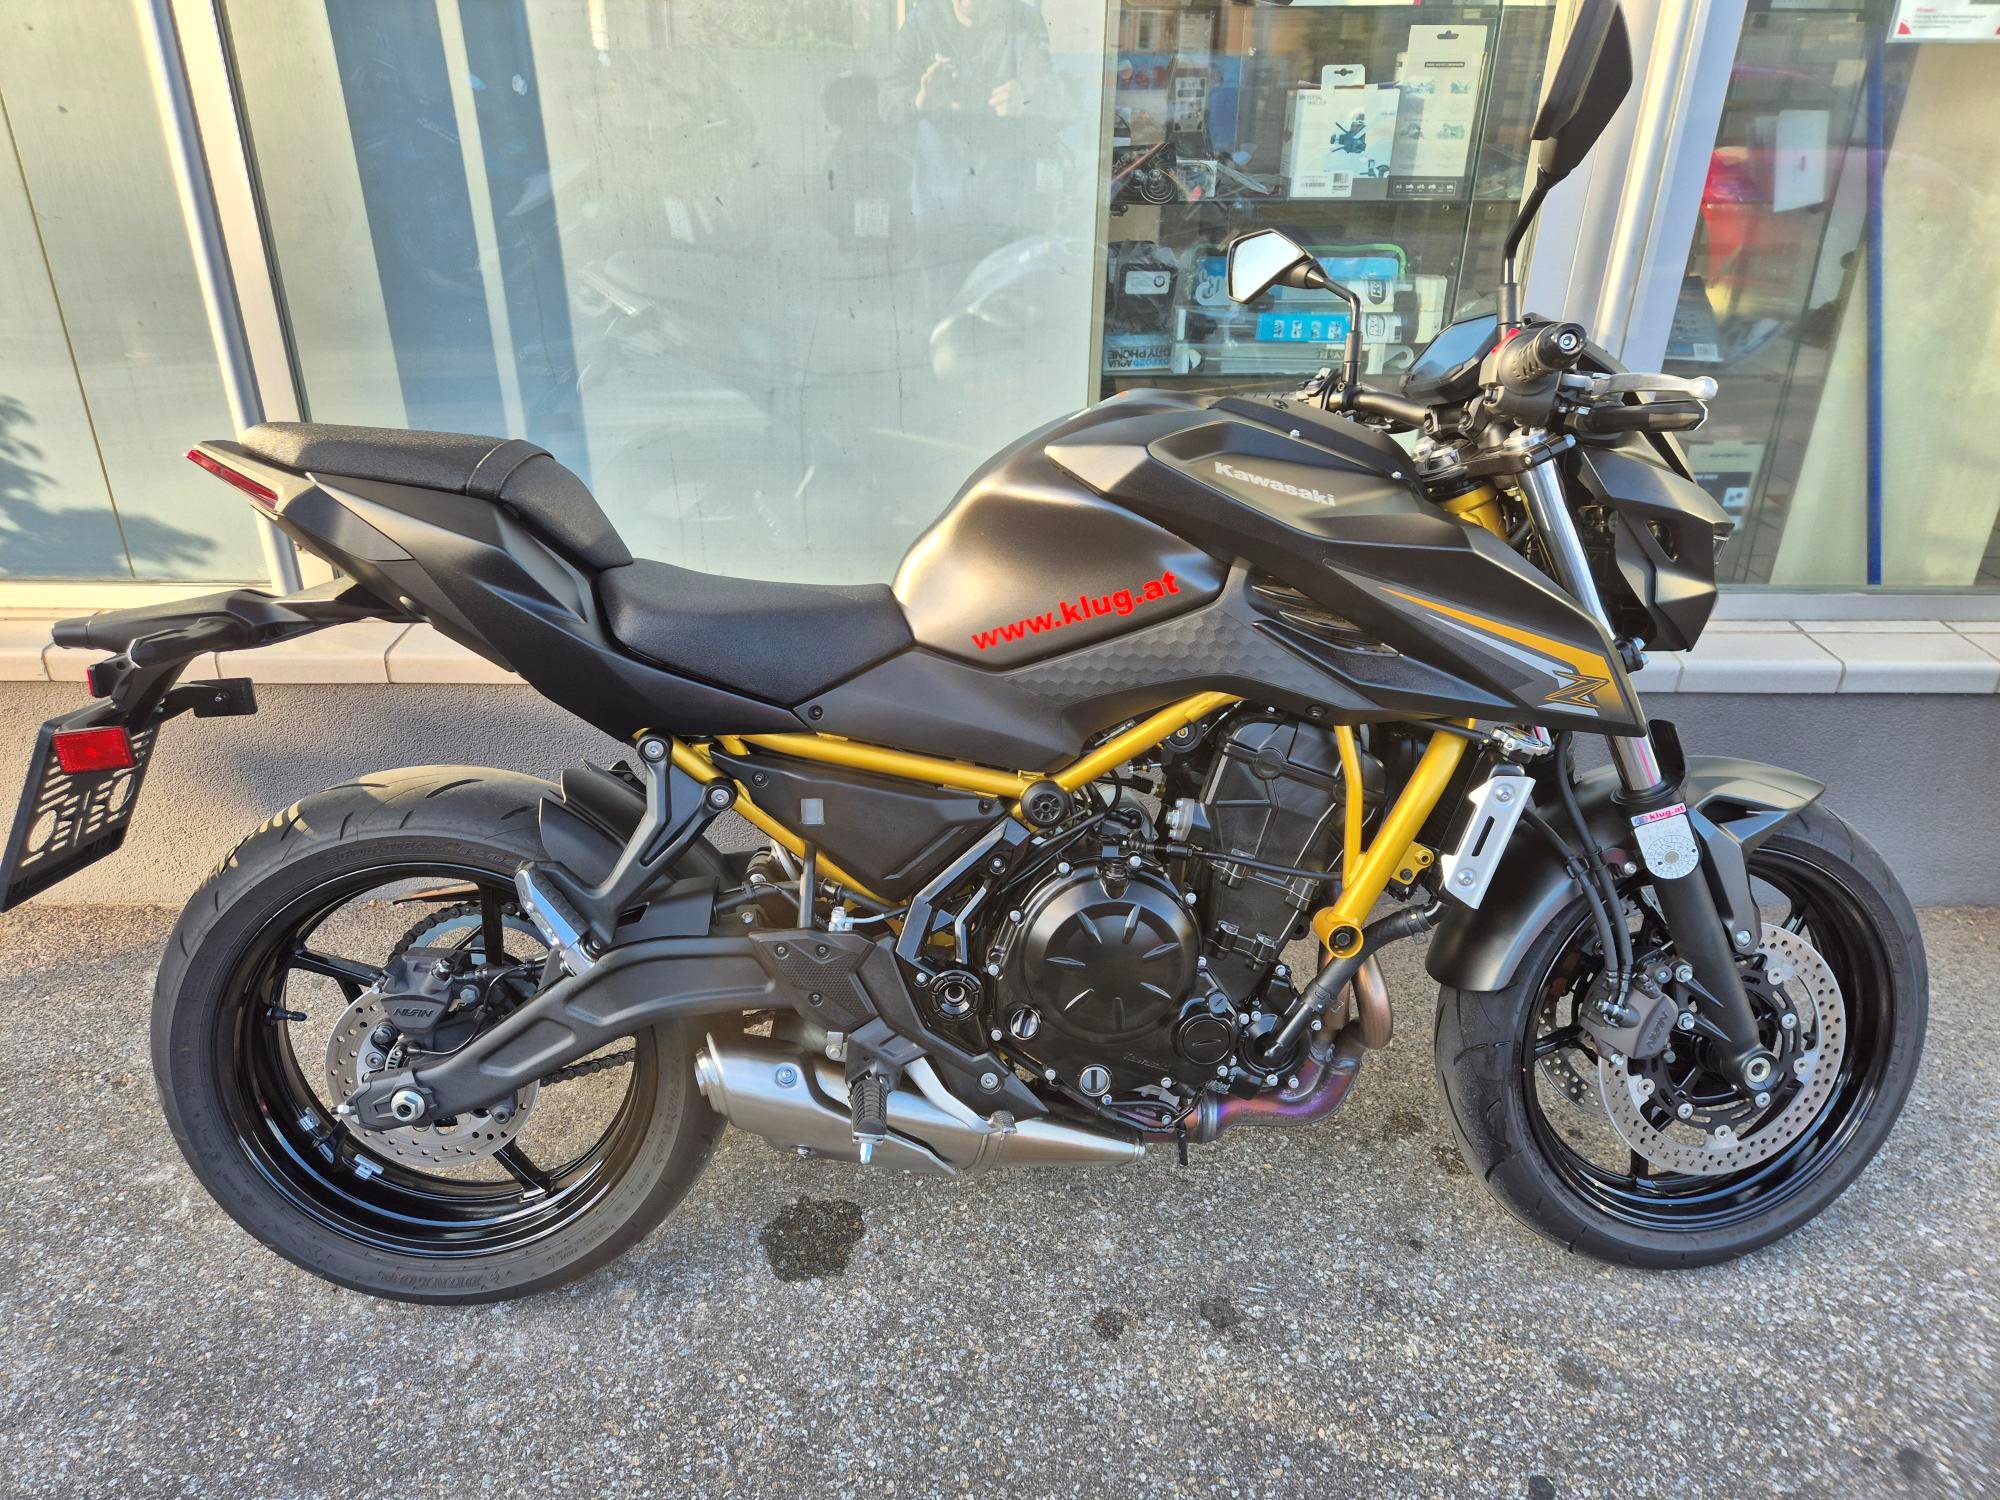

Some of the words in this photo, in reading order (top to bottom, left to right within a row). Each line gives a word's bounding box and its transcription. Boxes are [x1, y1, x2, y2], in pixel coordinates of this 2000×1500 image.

[1107, 348, 1146, 360] PHONE
[1214, 461, 1336, 506] Kawasaki
[1649, 805, 1686, 820] klug.at
